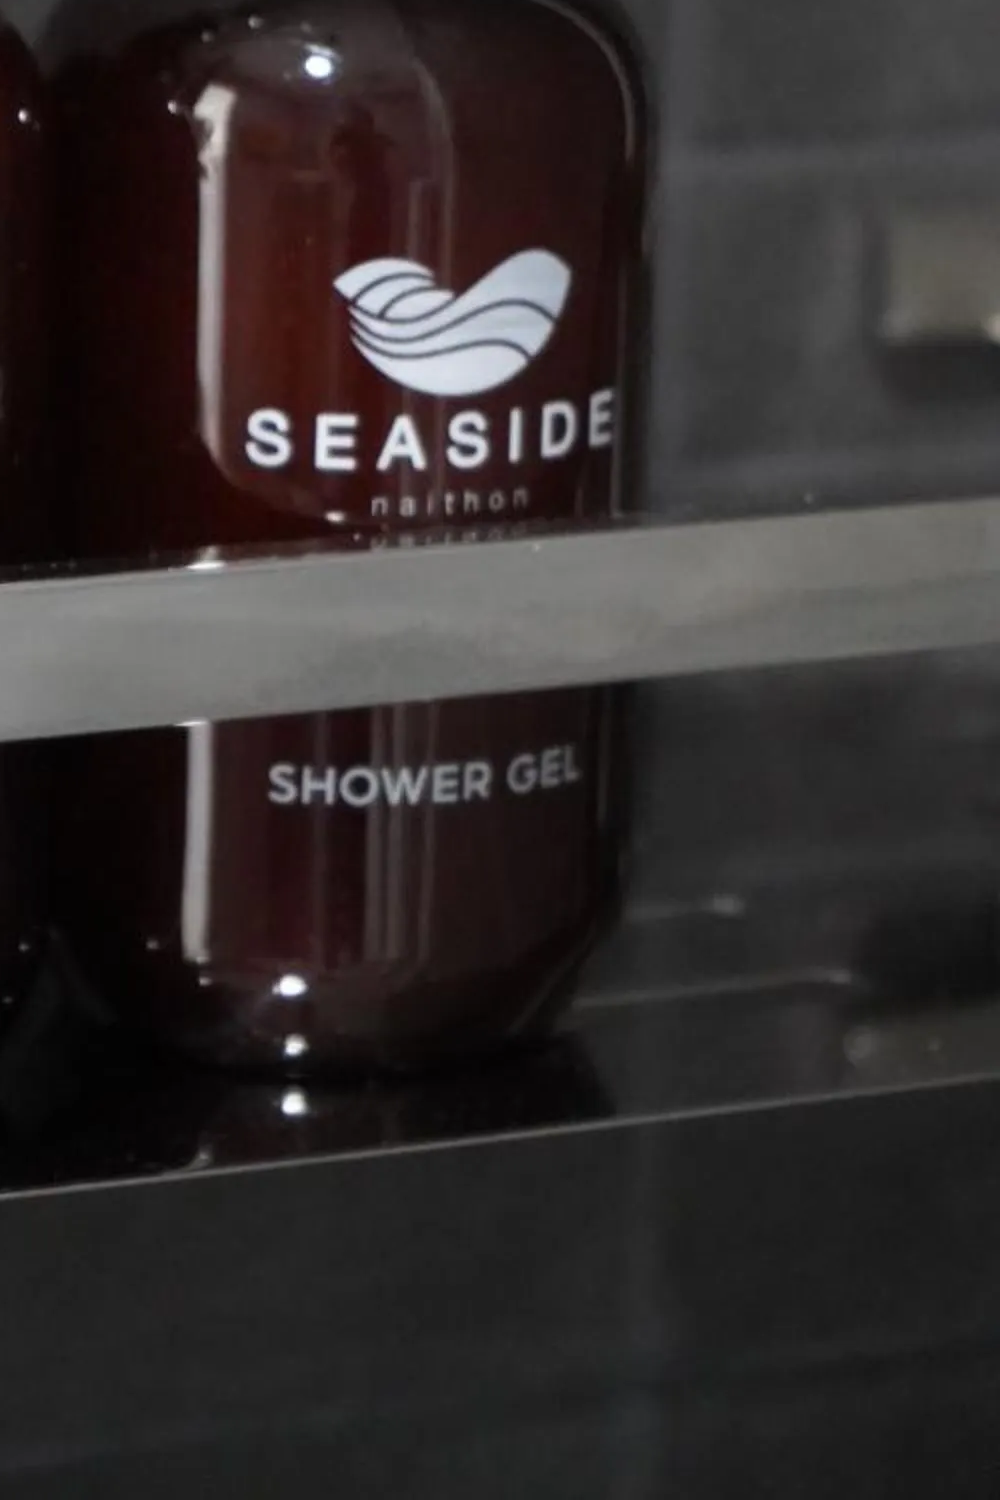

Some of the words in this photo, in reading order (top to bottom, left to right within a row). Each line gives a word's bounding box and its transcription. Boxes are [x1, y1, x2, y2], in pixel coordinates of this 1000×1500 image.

[245, 389, 615, 471] SEASIDE
[370, 486, 530, 517] naithon
[267, 760, 492, 806] SHOWER
[506, 744, 581, 794] GEL
